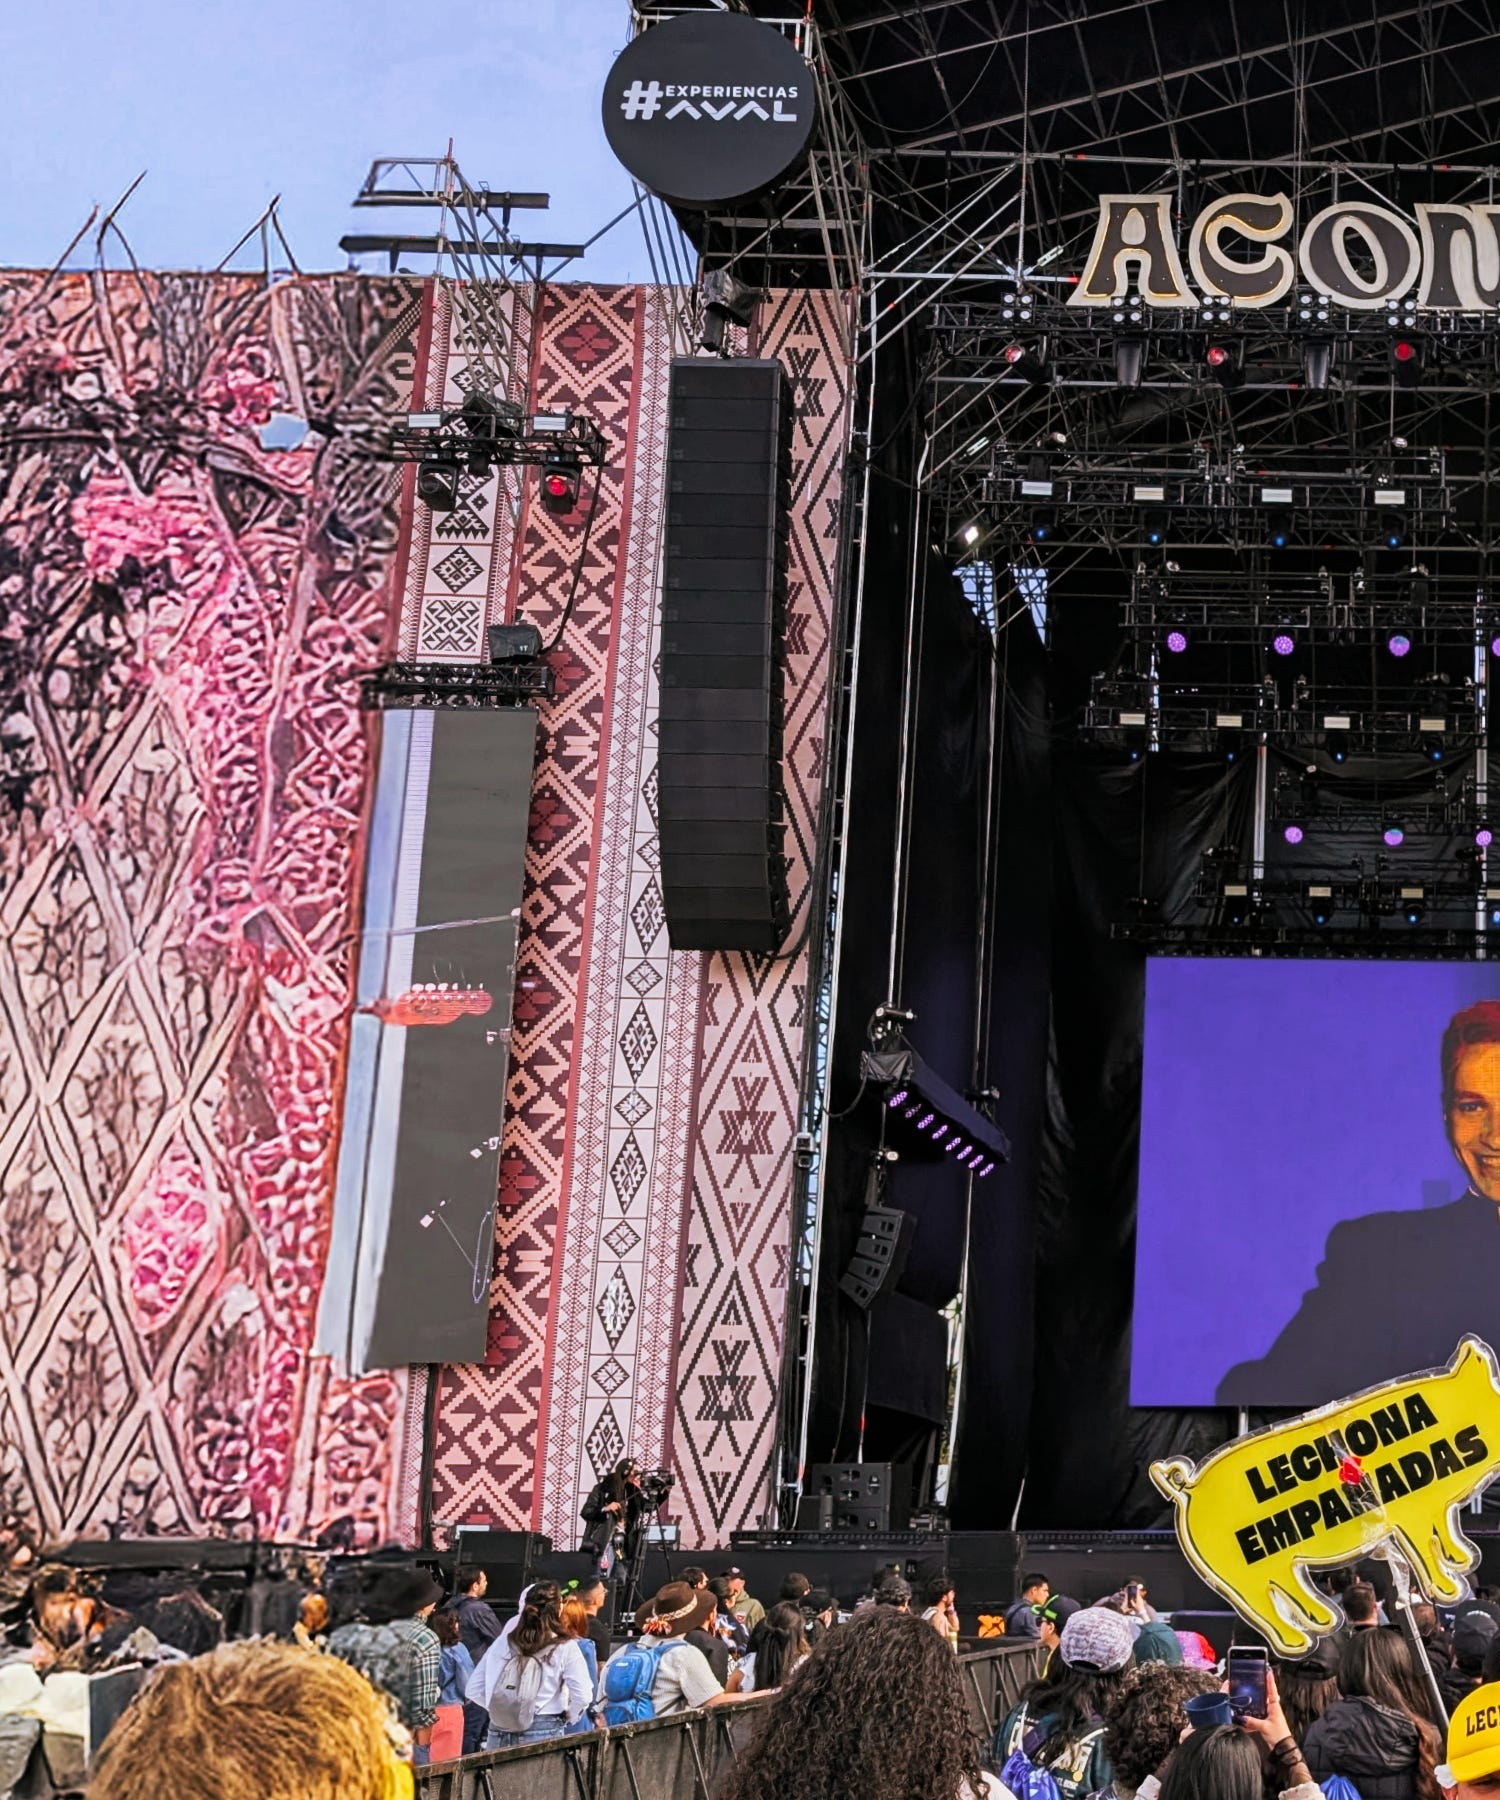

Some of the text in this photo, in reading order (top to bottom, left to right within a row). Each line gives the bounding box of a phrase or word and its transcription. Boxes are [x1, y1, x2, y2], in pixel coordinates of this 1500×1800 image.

[664, 100, 798, 122] AVAL
[1234, 1425, 1489, 1565] EMPANADAS
[1245, 1393, 1439, 1504] LECHONA
